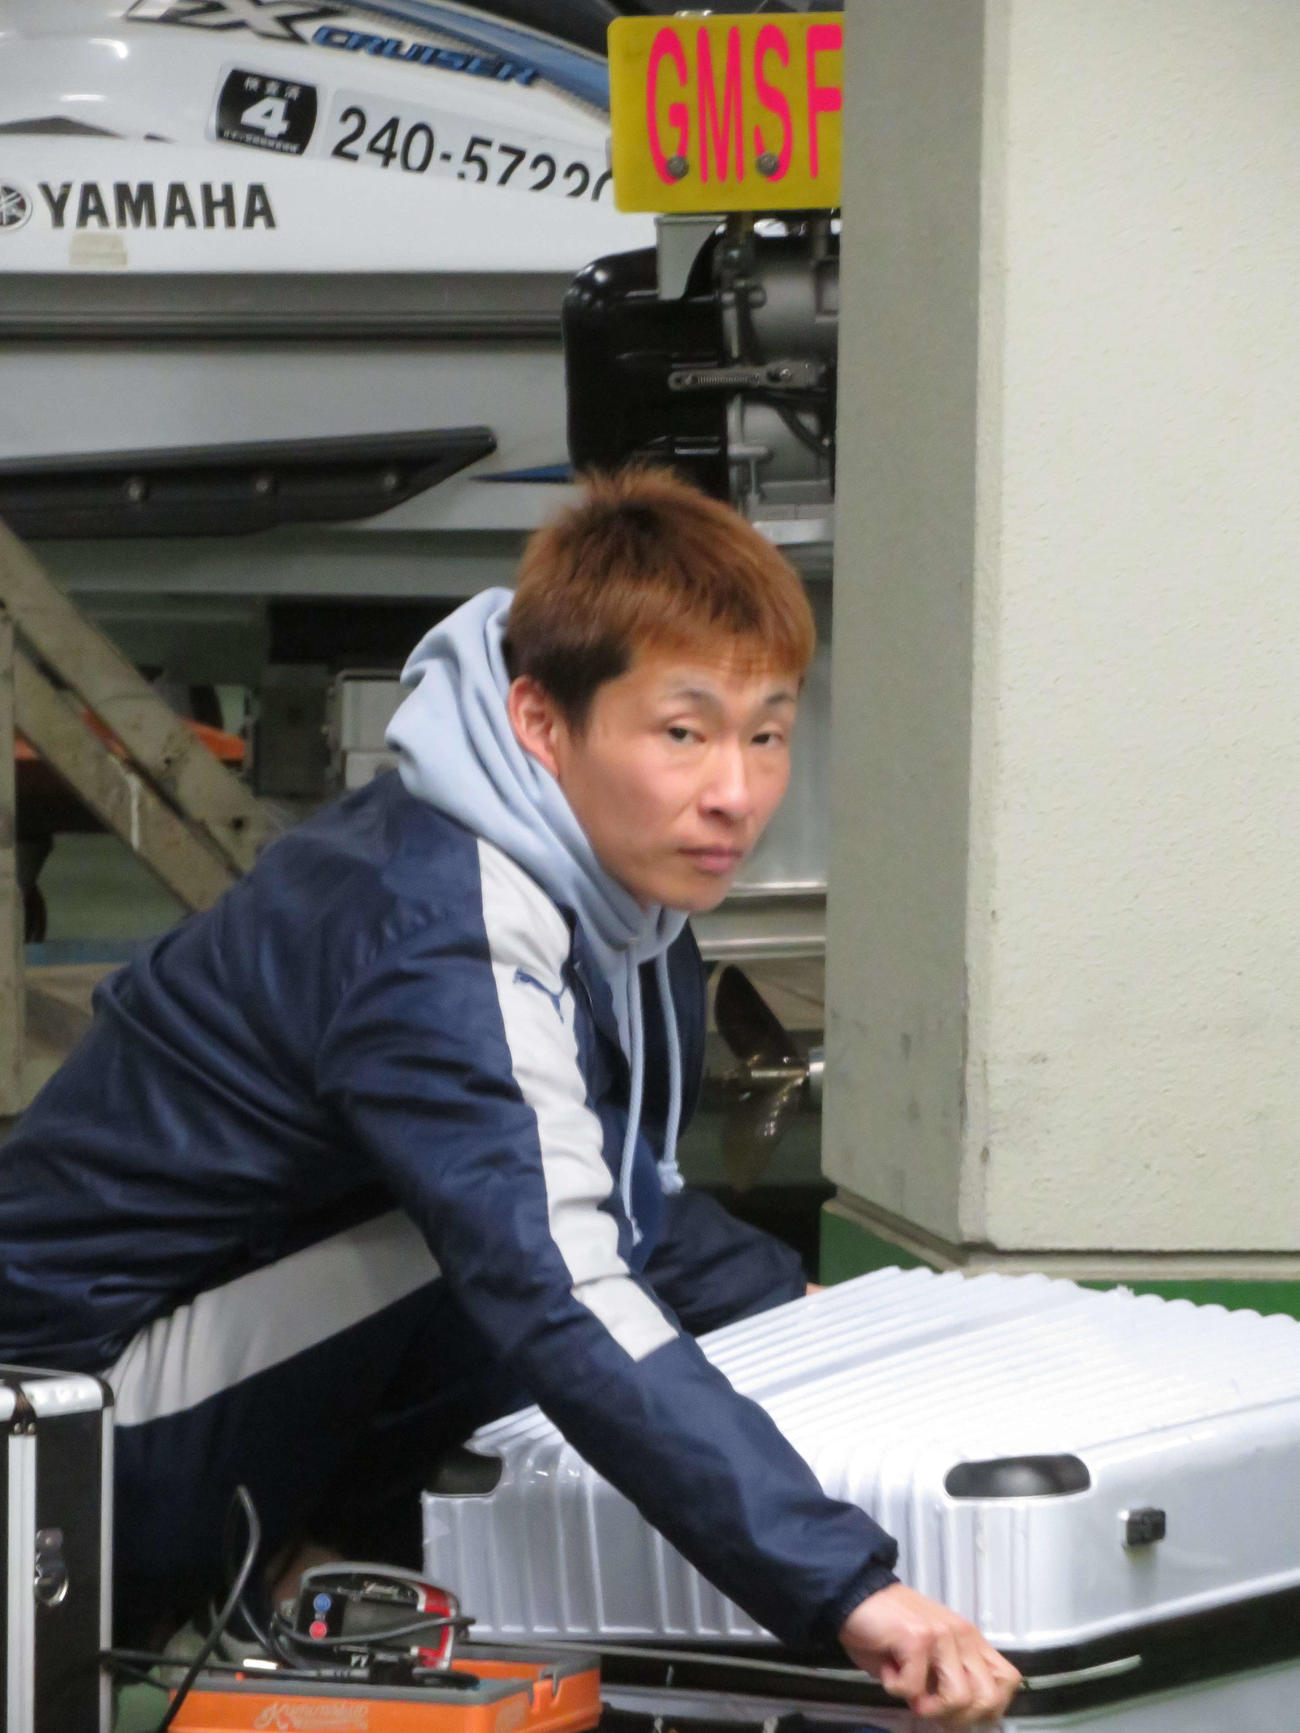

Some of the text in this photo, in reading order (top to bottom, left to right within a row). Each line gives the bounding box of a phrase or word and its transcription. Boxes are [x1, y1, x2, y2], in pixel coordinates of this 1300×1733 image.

[312, 25, 538, 86] CRUISER
[240, 96, 290, 139] 4
[646, 23, 843, 186] GMSF
[38, 182, 277, 229] YAMAHA
